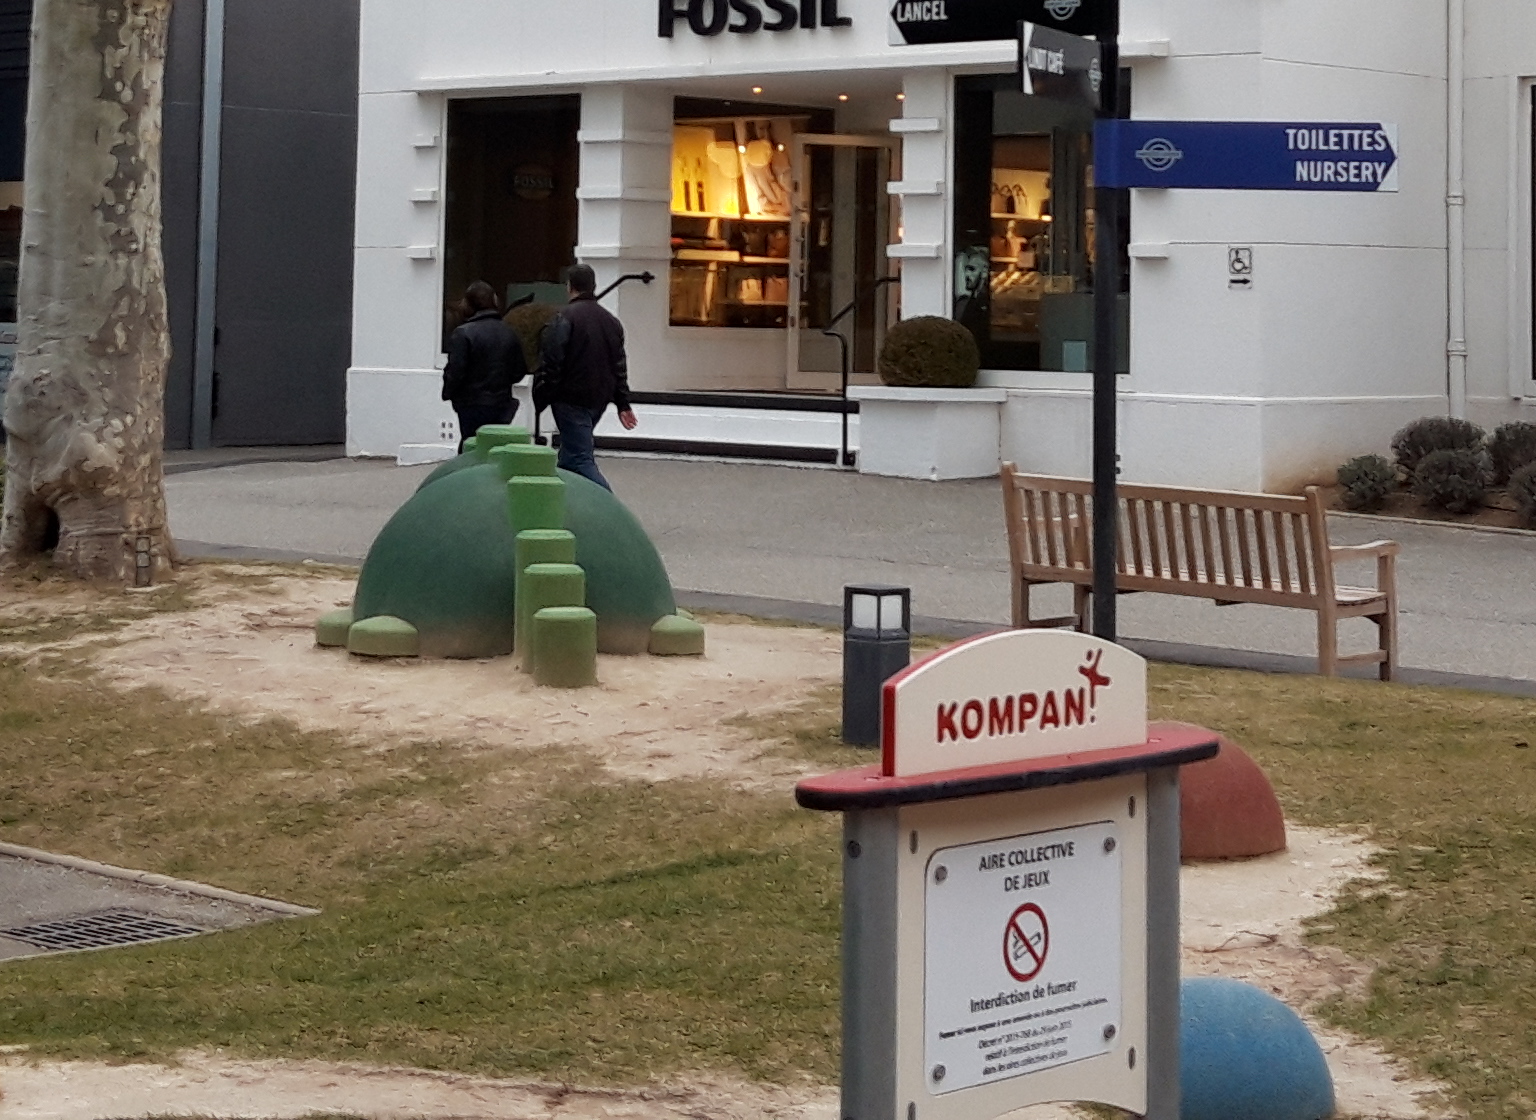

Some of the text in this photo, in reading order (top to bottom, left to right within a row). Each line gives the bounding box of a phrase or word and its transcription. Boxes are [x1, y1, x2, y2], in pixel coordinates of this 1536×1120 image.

[896, 0, 948, 22] LANCEL
[1285, 128, 1386, 151] TOILETTES
[1295, 160, 1386, 182] NURSERY
[979, 841, 1075, 871] AIRE COLLECTIVE
[1004, 870, 1050, 892] DE JEUX
[970, 980, 1077, 1013] Interdiction de fumer
